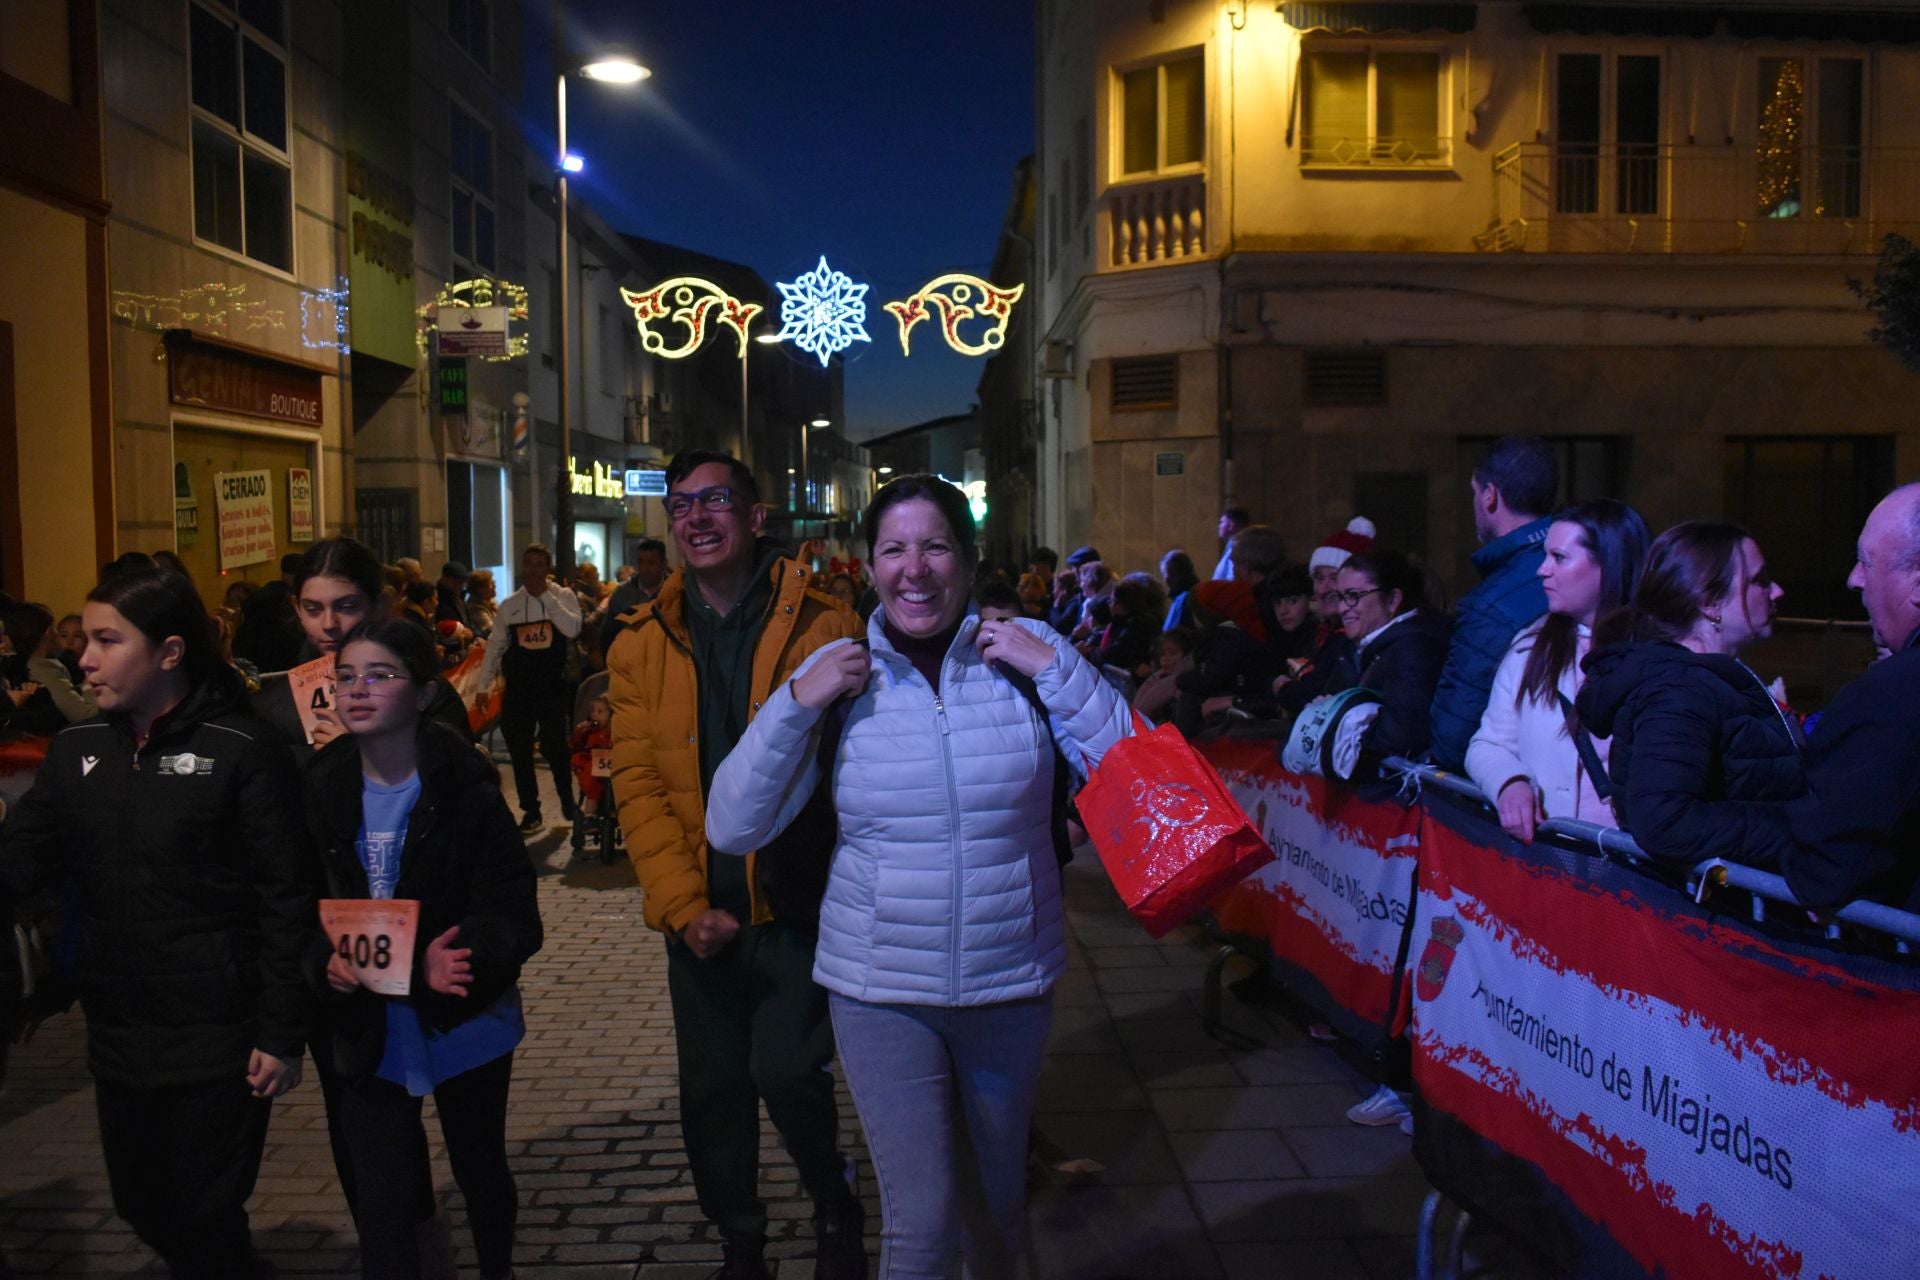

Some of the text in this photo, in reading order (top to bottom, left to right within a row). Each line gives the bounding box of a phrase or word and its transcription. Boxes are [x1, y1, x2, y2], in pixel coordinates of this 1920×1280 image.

[270, 393, 318, 420] BOUTIQUE
[222, 475, 266, 500] CERRADO
[340, 934, 391, 969] 408
[1601, 1052, 1632, 1101] de
[1642, 1064, 1793, 1190] Miajadas
